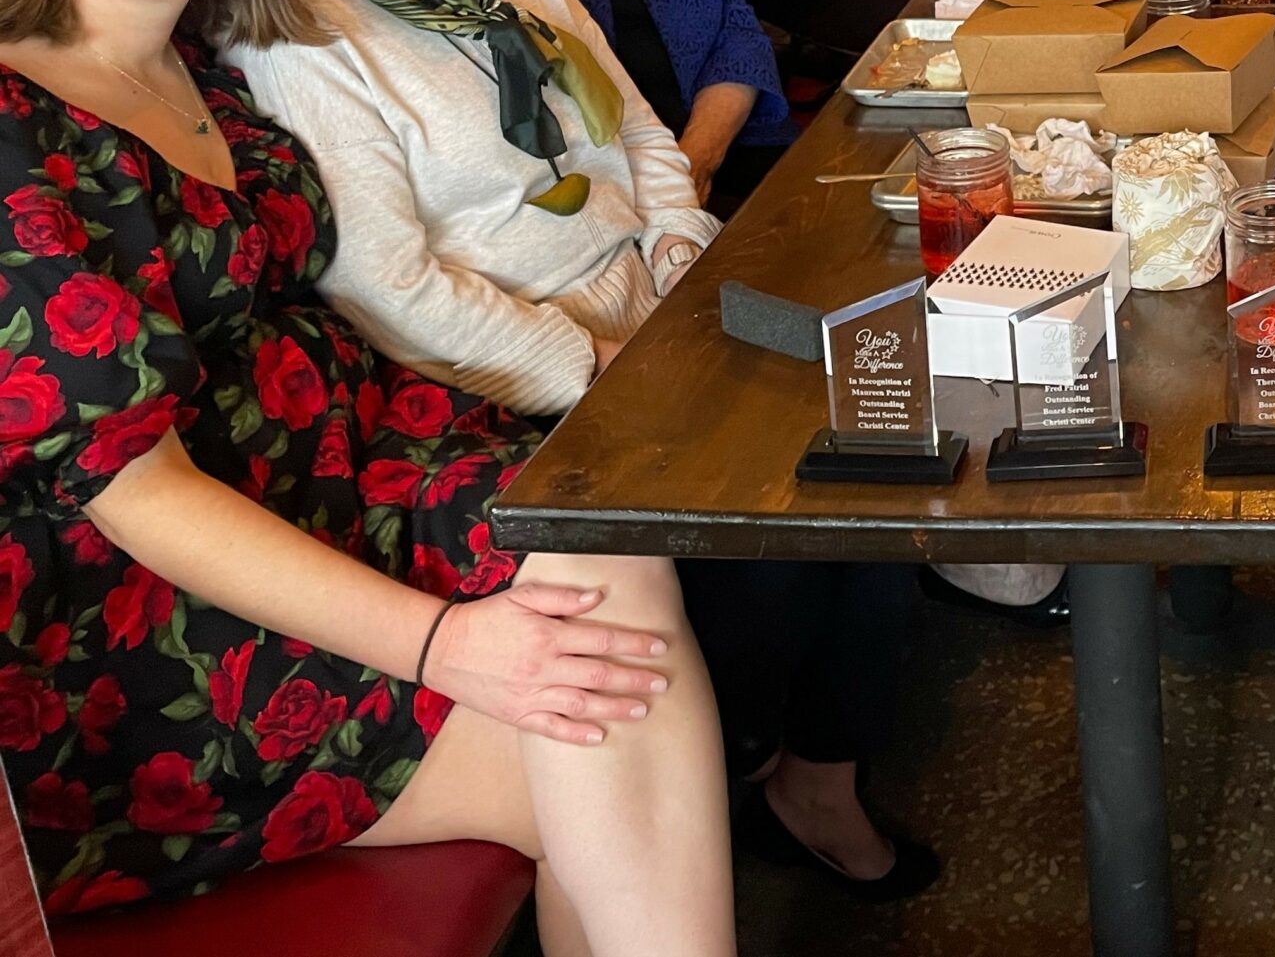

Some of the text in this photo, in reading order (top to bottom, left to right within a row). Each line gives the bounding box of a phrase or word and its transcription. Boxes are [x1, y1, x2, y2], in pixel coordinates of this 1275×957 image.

[856, 328, 892, 352] You
[854, 356, 904, 373] Difference
[1089, 371, 1099, 379] of
[1250, 367, 1259, 375] In
[848, 377, 912, 387] In Recognition of
[851, 388, 884, 396] Maureen
[1044, 385, 1063, 393] Fred
[860, 399, 905, 409] Outstanding
[1044, 395, 1091, 404] Outstanding
[857, 410, 909, 419] Board Service
[1043, 406, 1095, 415] Board Service
[857, 421, 911, 430] Christi Center
[1042, 417, 1096, 426] Christi Center
